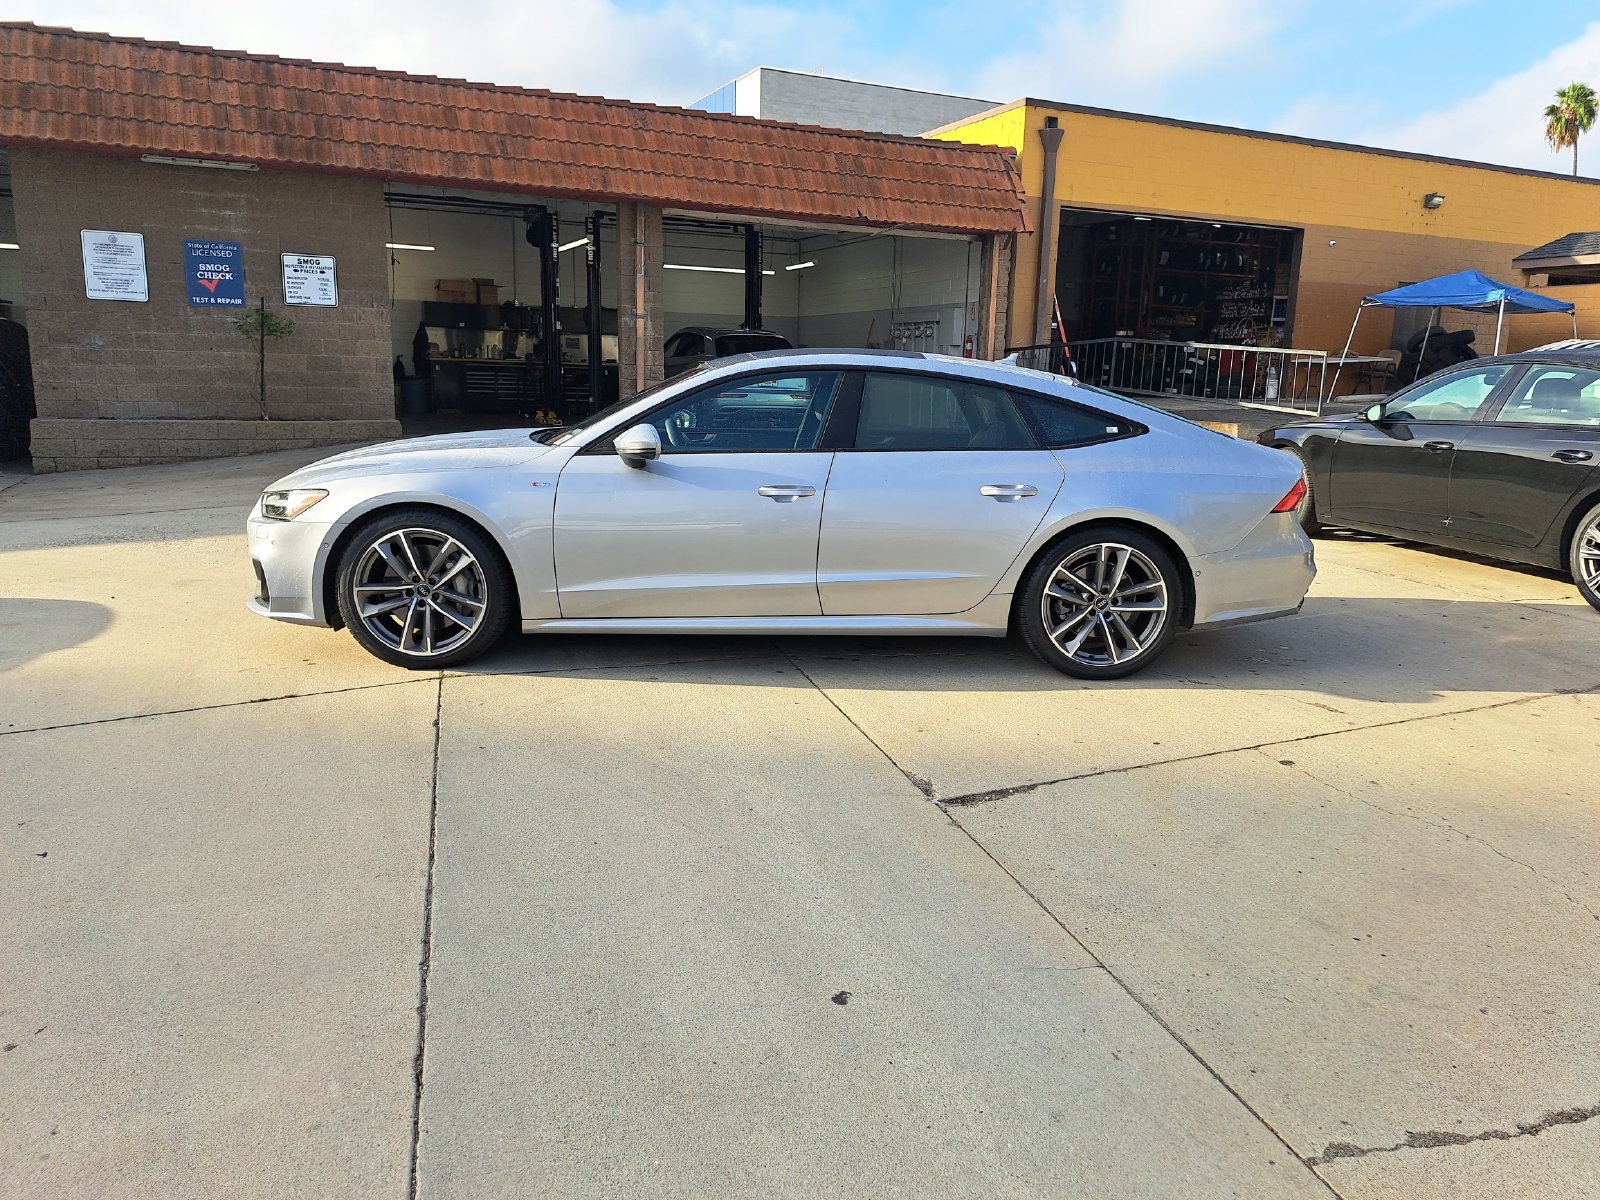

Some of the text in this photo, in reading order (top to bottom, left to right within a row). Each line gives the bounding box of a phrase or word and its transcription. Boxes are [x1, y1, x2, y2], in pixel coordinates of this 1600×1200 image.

[191, 249, 232, 258] LICENSED
[298, 258, 321, 266] SMOG
[198, 263, 230, 272] SMOG
[196, 271, 234, 280] CHECK
